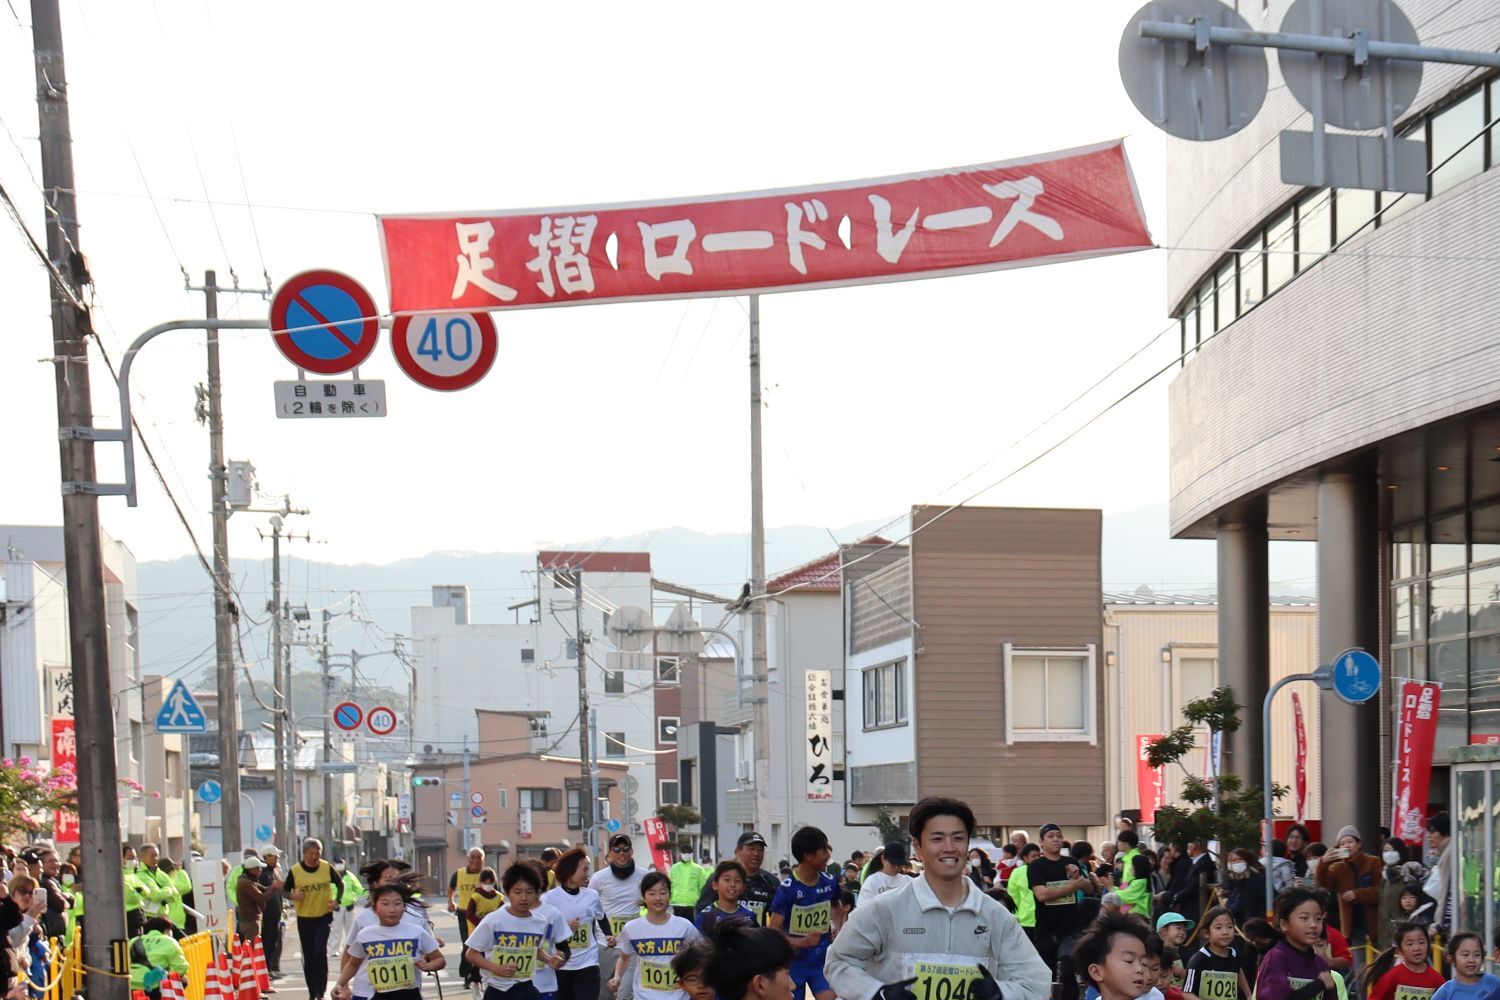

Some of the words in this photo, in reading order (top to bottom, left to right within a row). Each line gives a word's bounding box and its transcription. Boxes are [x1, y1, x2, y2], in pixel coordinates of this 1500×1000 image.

[451, 175, 1066, 300] 足摺ロードレース
[417, 317, 473, 362] 40
[294, 384, 367, 398] 自動車
[373, 714, 391, 728] 40
[1402, 694, 1417, 782] ロードレース
[808, 734, 830, 785] ひろ
[202, 882, 219, 927] ゴール
[797, 909, 829, 928] 1022
[567, 928, 588, 945] 48
[613, 922, 625, 935] 10
[367, 943, 385, 957] 大方
[387, 941, 414, 956] JAC
[636, 941, 656, 954] 大方
[371, 964, 409, 984] 1011
[645, 967, 680, 987] 1012
[1206, 979, 1236, 998] 1026
